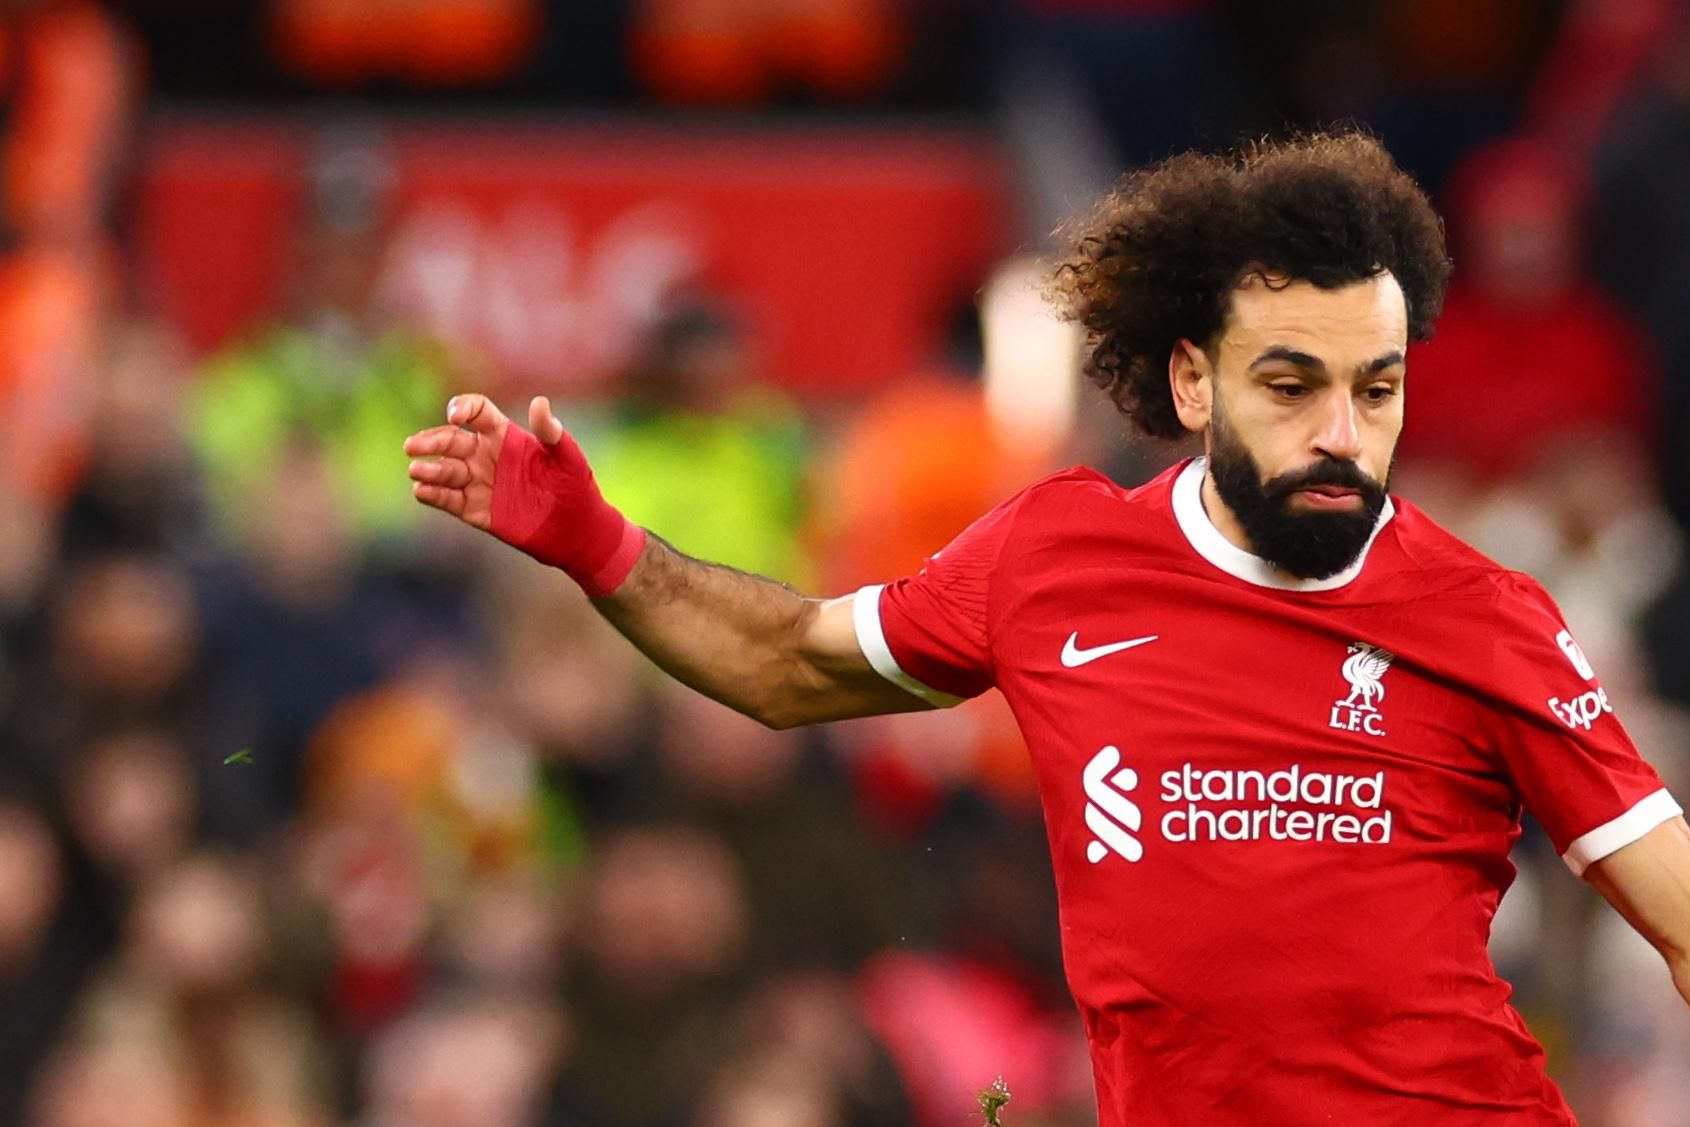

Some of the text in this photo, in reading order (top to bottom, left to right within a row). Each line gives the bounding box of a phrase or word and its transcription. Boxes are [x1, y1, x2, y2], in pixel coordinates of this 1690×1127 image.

[1328, 706, 1386, 737] L.F.C.
[1160, 762, 1384, 810] standard
[1160, 802, 1393, 845] chartered
